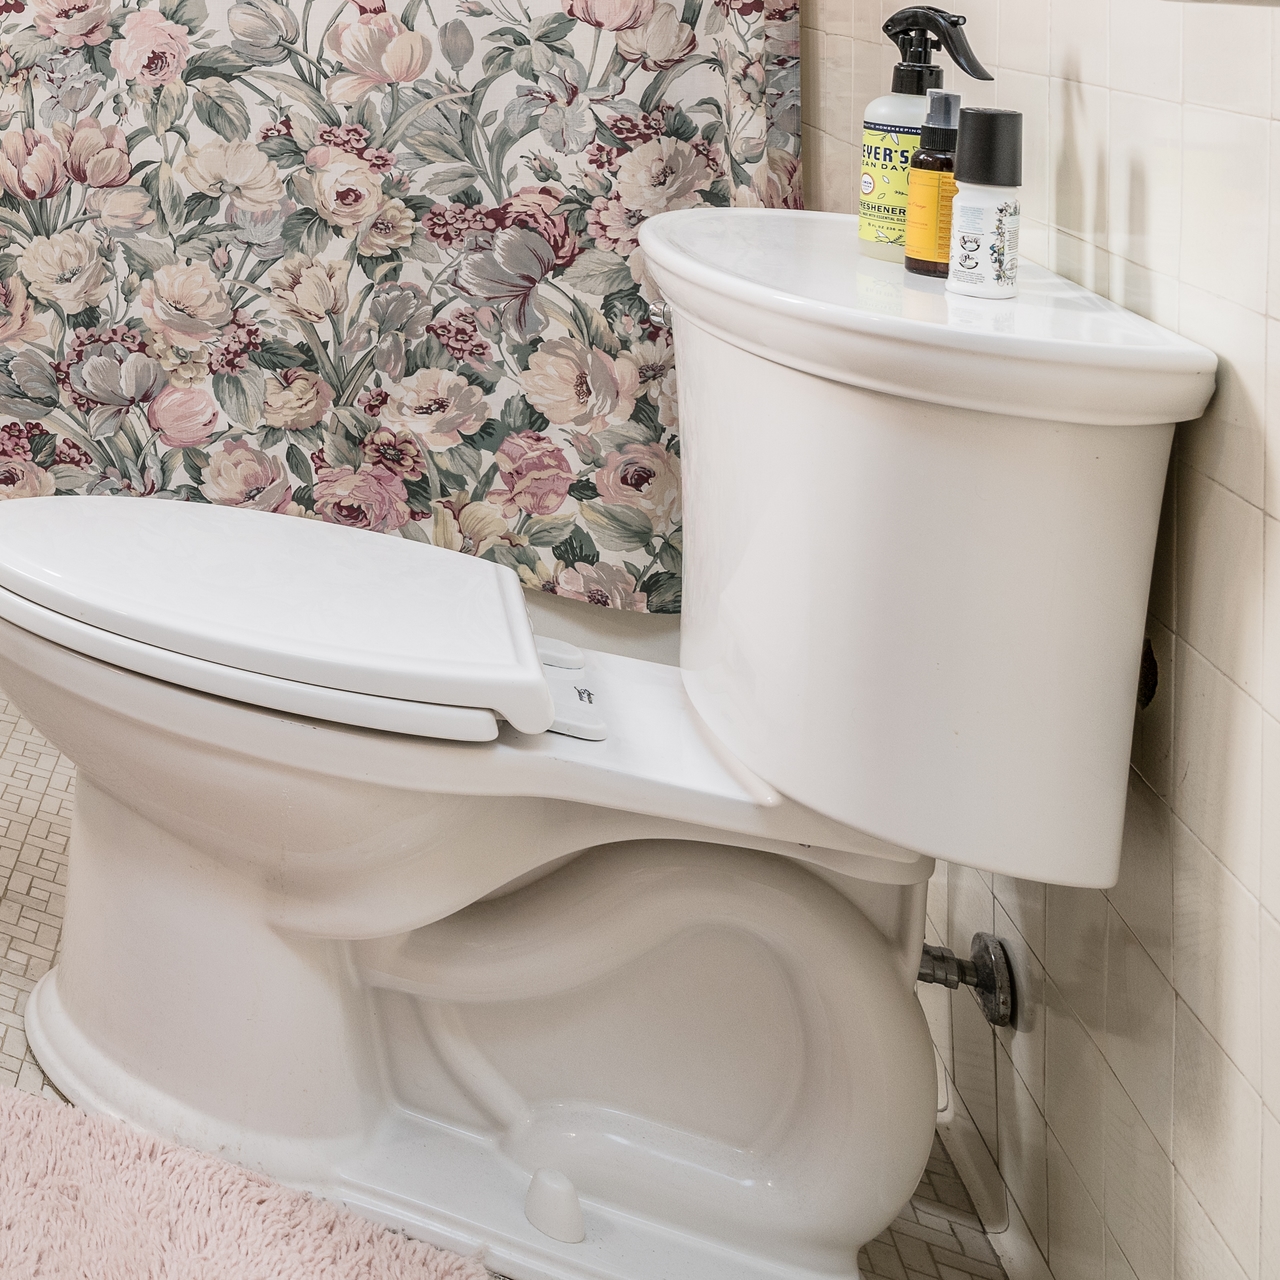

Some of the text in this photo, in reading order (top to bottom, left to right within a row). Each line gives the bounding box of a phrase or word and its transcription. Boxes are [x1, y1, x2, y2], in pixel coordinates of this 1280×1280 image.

[876, 125, 921, 133] HOMEKEEPING
[881, 164, 908, 172] DAY
[876, 213, 895, 221] ESSENTIAL
